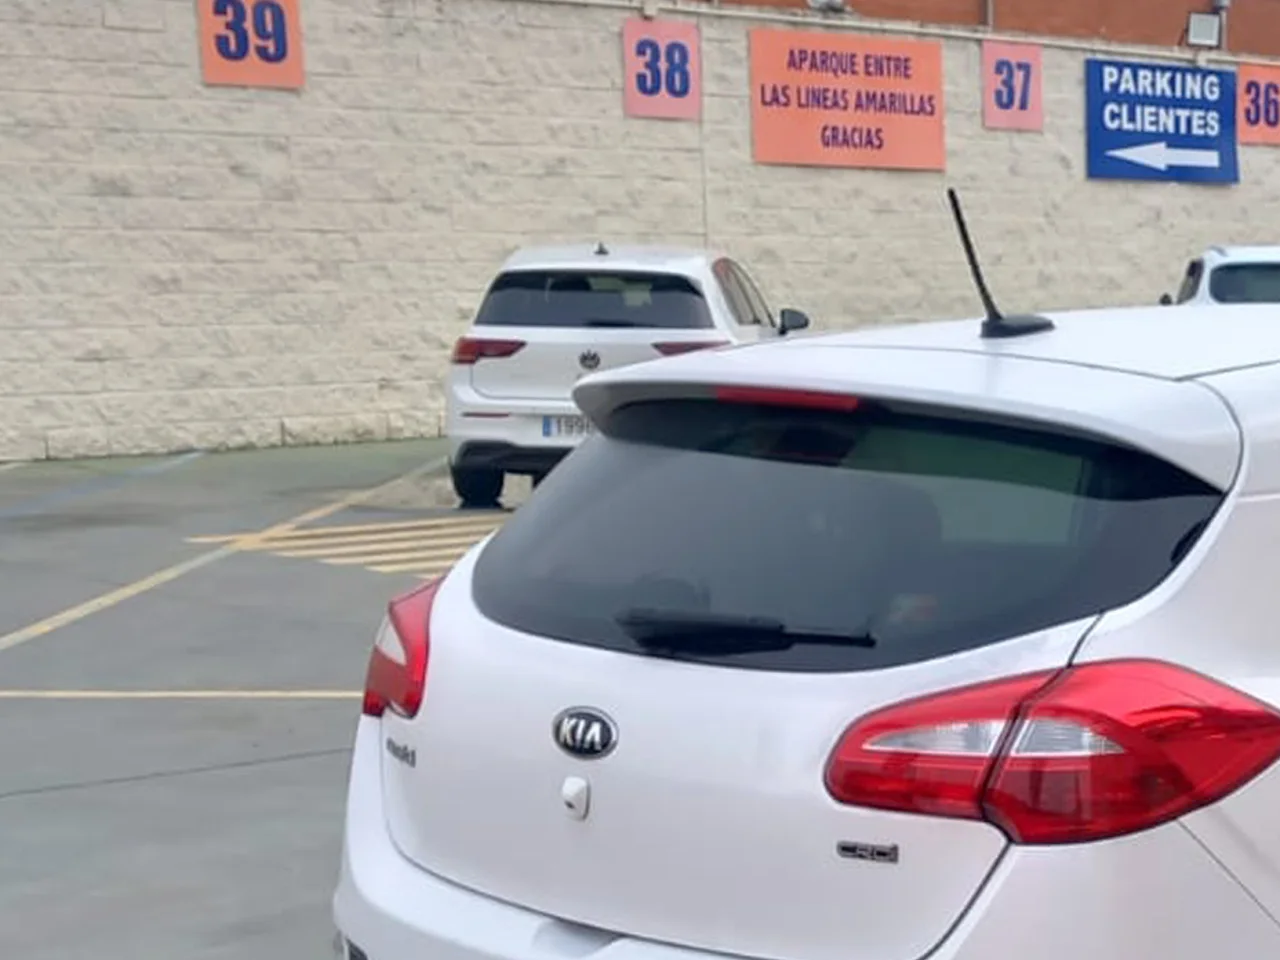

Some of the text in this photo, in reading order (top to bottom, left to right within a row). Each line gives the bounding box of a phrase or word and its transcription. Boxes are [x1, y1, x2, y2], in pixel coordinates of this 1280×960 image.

[213, 0, 288, 63] 39
[635, 38, 690, 98] 38
[787, 49, 912, 79] APARQUE ENTRE
[760, 83, 936, 116] LAS LINEAS AMARILLAS
[994, 59, 1032, 111] 37
[1103, 66, 1220, 100] PARKING
[1103, 103, 1220, 136] CLIENTES
[1244, 80, 1280, 127] 36
[821, 125, 884, 149] GRACIAS
[561, 718, 602, 751] KIA
